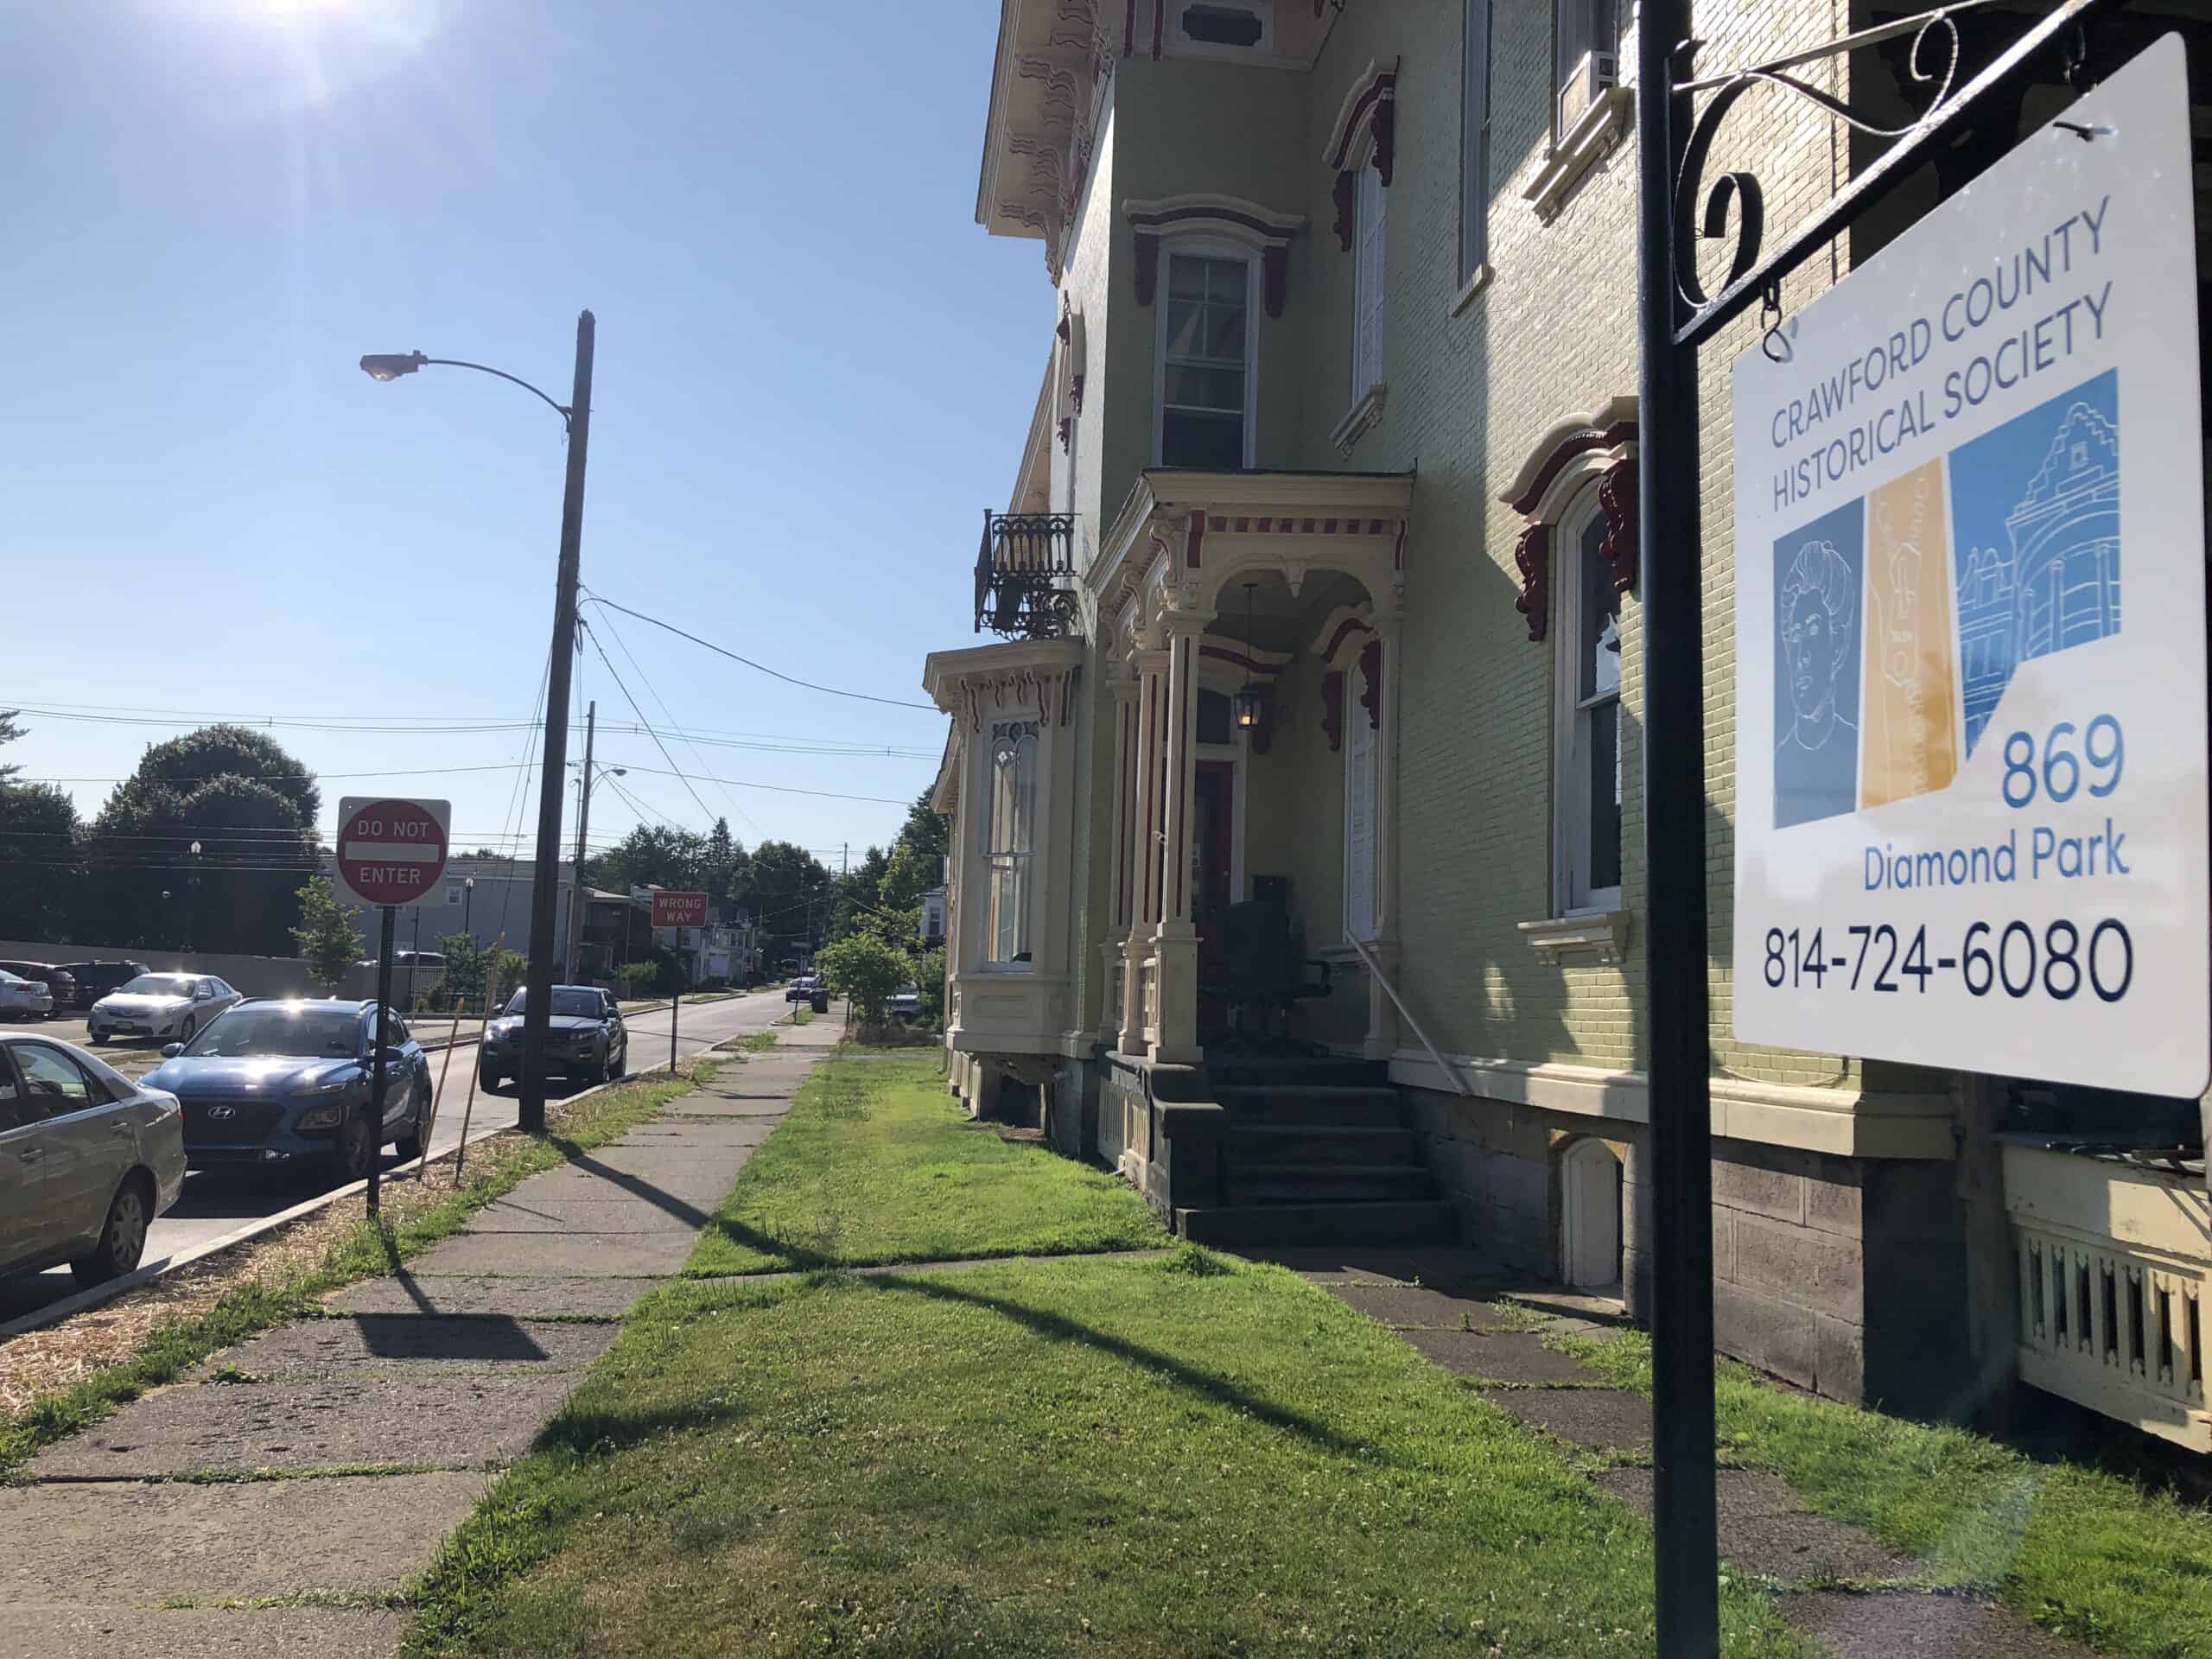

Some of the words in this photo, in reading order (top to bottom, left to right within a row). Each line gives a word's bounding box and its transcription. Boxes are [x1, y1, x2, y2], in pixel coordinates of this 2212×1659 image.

[1771, 318, 1931, 448] CRAWFORD
[1942, 195, 2110, 342] COUNTY
[1774, 390, 1936, 512] HISTORICAL
[1944, 281, 2113, 418] SOCIETY
[2002, 714, 2124, 808] 869
[359, 820, 382, 836] DO
[393, 822, 429, 837] NOT
[1865, 829, 2016, 890] Diamond
[2032, 817, 2130, 879] Park
[359, 867, 421, 884] ENTER
[659, 898, 702, 909] WRONG
[666, 912, 692, 923] WAY
[1764, 918, 2133, 1001] 814-724-6080
